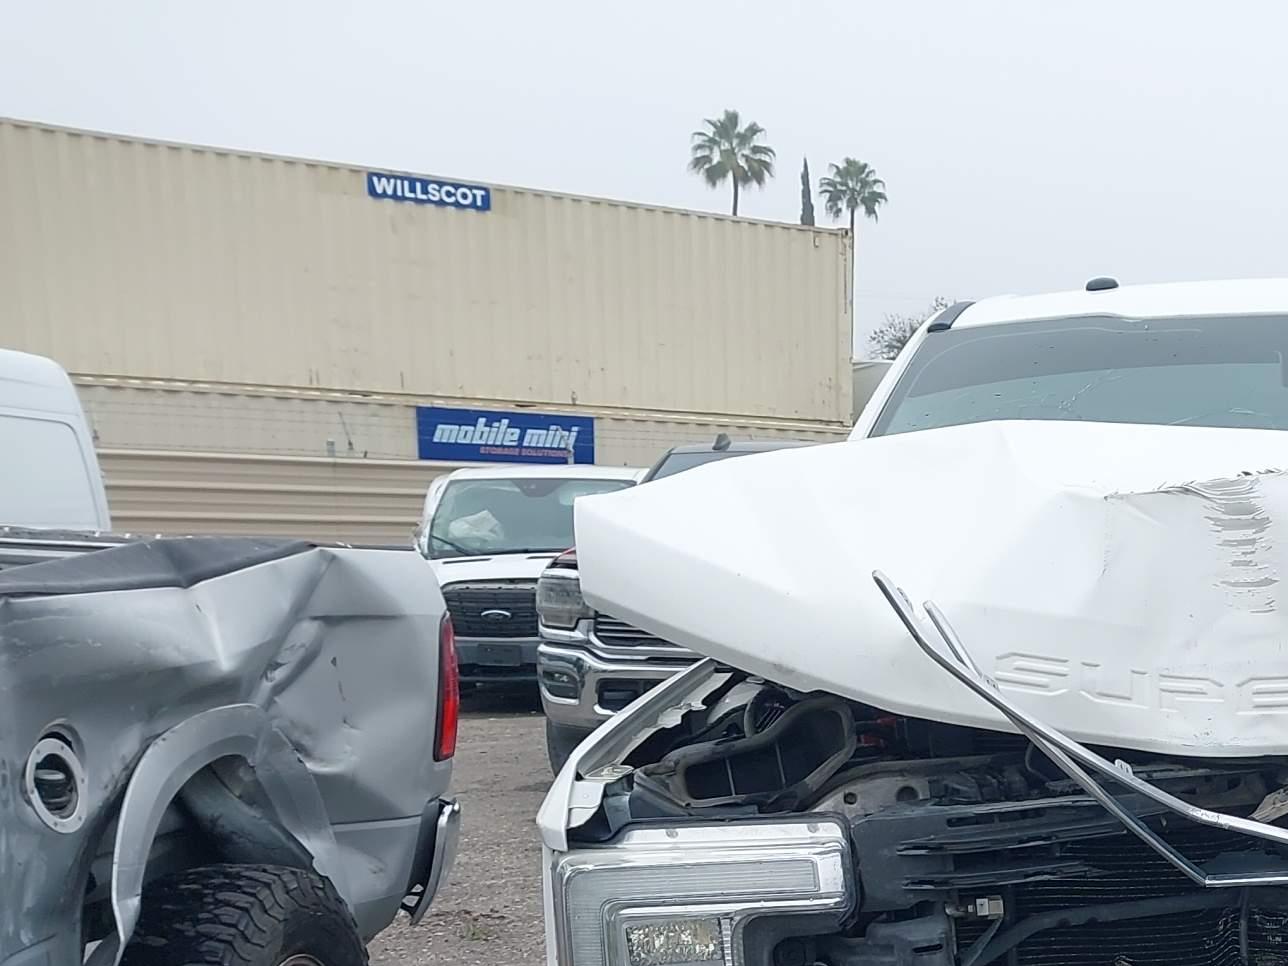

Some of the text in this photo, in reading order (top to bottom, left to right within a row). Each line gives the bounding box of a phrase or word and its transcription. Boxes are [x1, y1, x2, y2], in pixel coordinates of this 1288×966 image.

[372, 176, 486, 206] WILLSCOT
[432, 417, 580, 449] mobile mini
[480, 446, 519, 456] STORAGE
